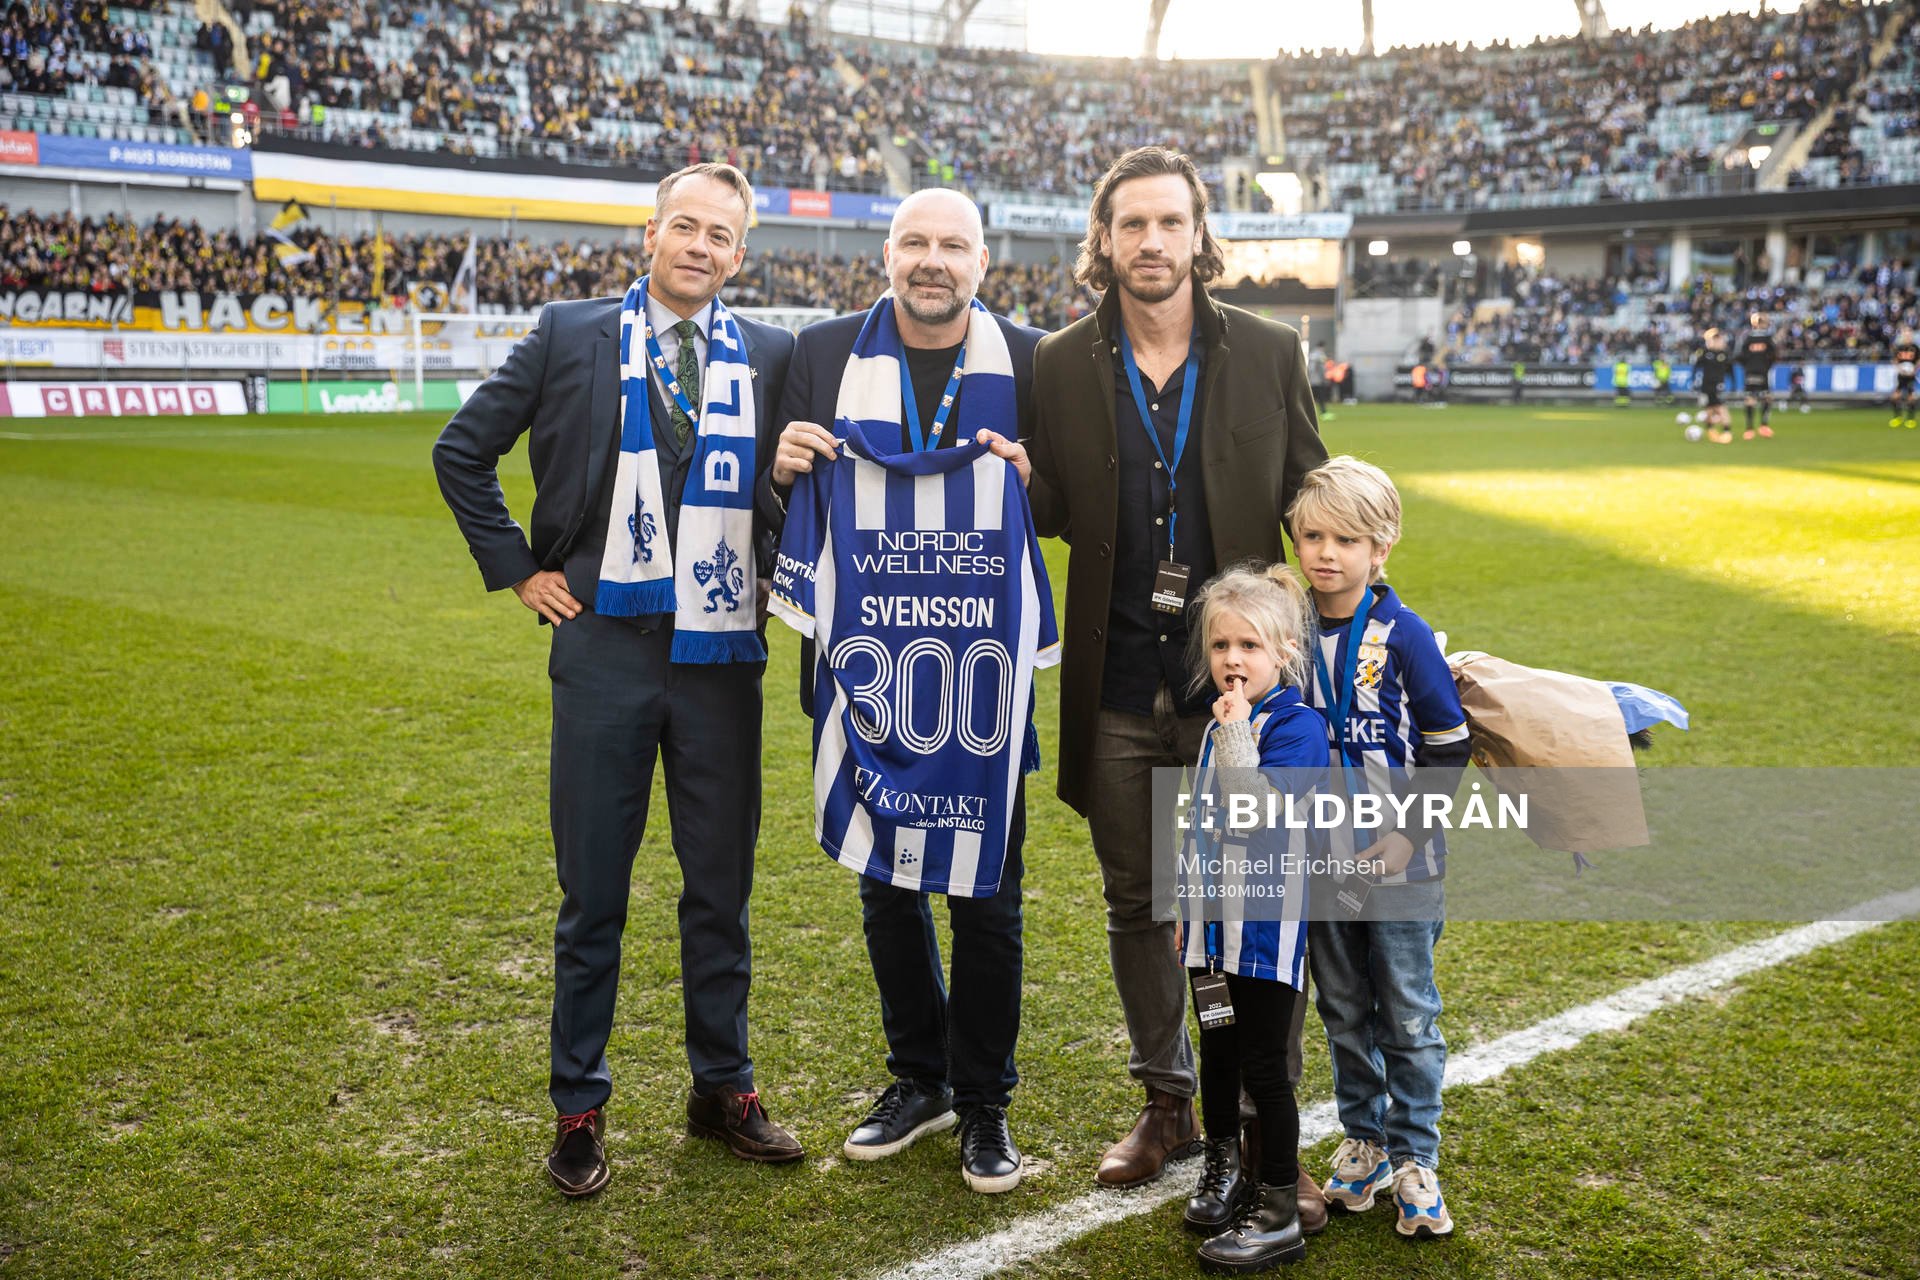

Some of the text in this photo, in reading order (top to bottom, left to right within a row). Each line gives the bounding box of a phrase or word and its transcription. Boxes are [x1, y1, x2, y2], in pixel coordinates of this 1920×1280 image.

[157, 151, 232, 171] NORDSTAN
[47, 390, 212, 411] CRAMO
[879, 532, 983, 551] NORDIC
[777, 552, 816, 583] morris
[853, 554, 1005, 576] WELLNESS
[861, 596, 994, 628] SVENSSON
[829, 635, 1013, 756] 300
[876, 787, 988, 817] KONTAKT
[938, 817, 985, 831] INSTALCO
[1208, 1002, 1222, 1010] 2022
